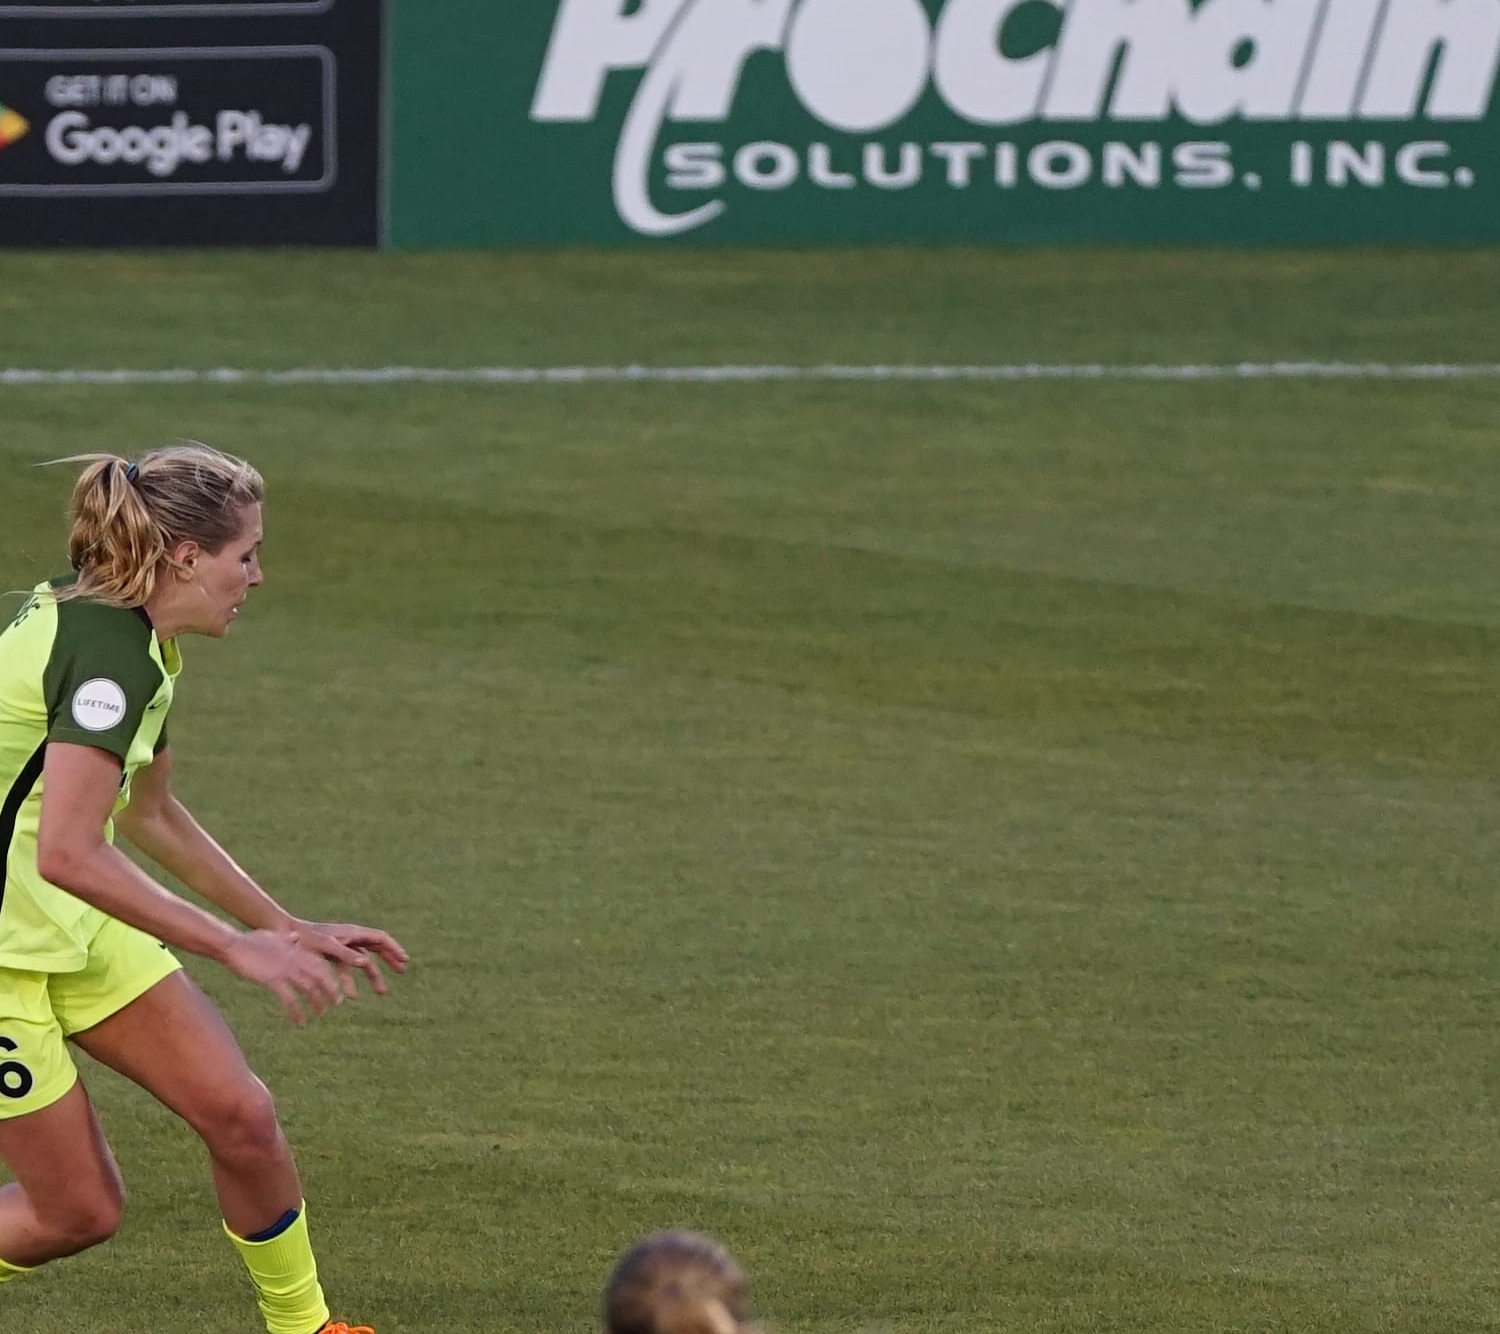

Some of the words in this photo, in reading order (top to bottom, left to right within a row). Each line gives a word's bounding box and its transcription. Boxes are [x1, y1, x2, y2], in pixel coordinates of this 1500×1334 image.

[46, 74, 102, 105] GET
[104, 74, 128, 104] IT
[130, 74, 177, 104] ON
[45, 110, 213, 176] Google
[216, 110, 312, 173] Play
[1292, 139, 1473, 187] INC.
[77, 698, 121, 713] LIFETIME
